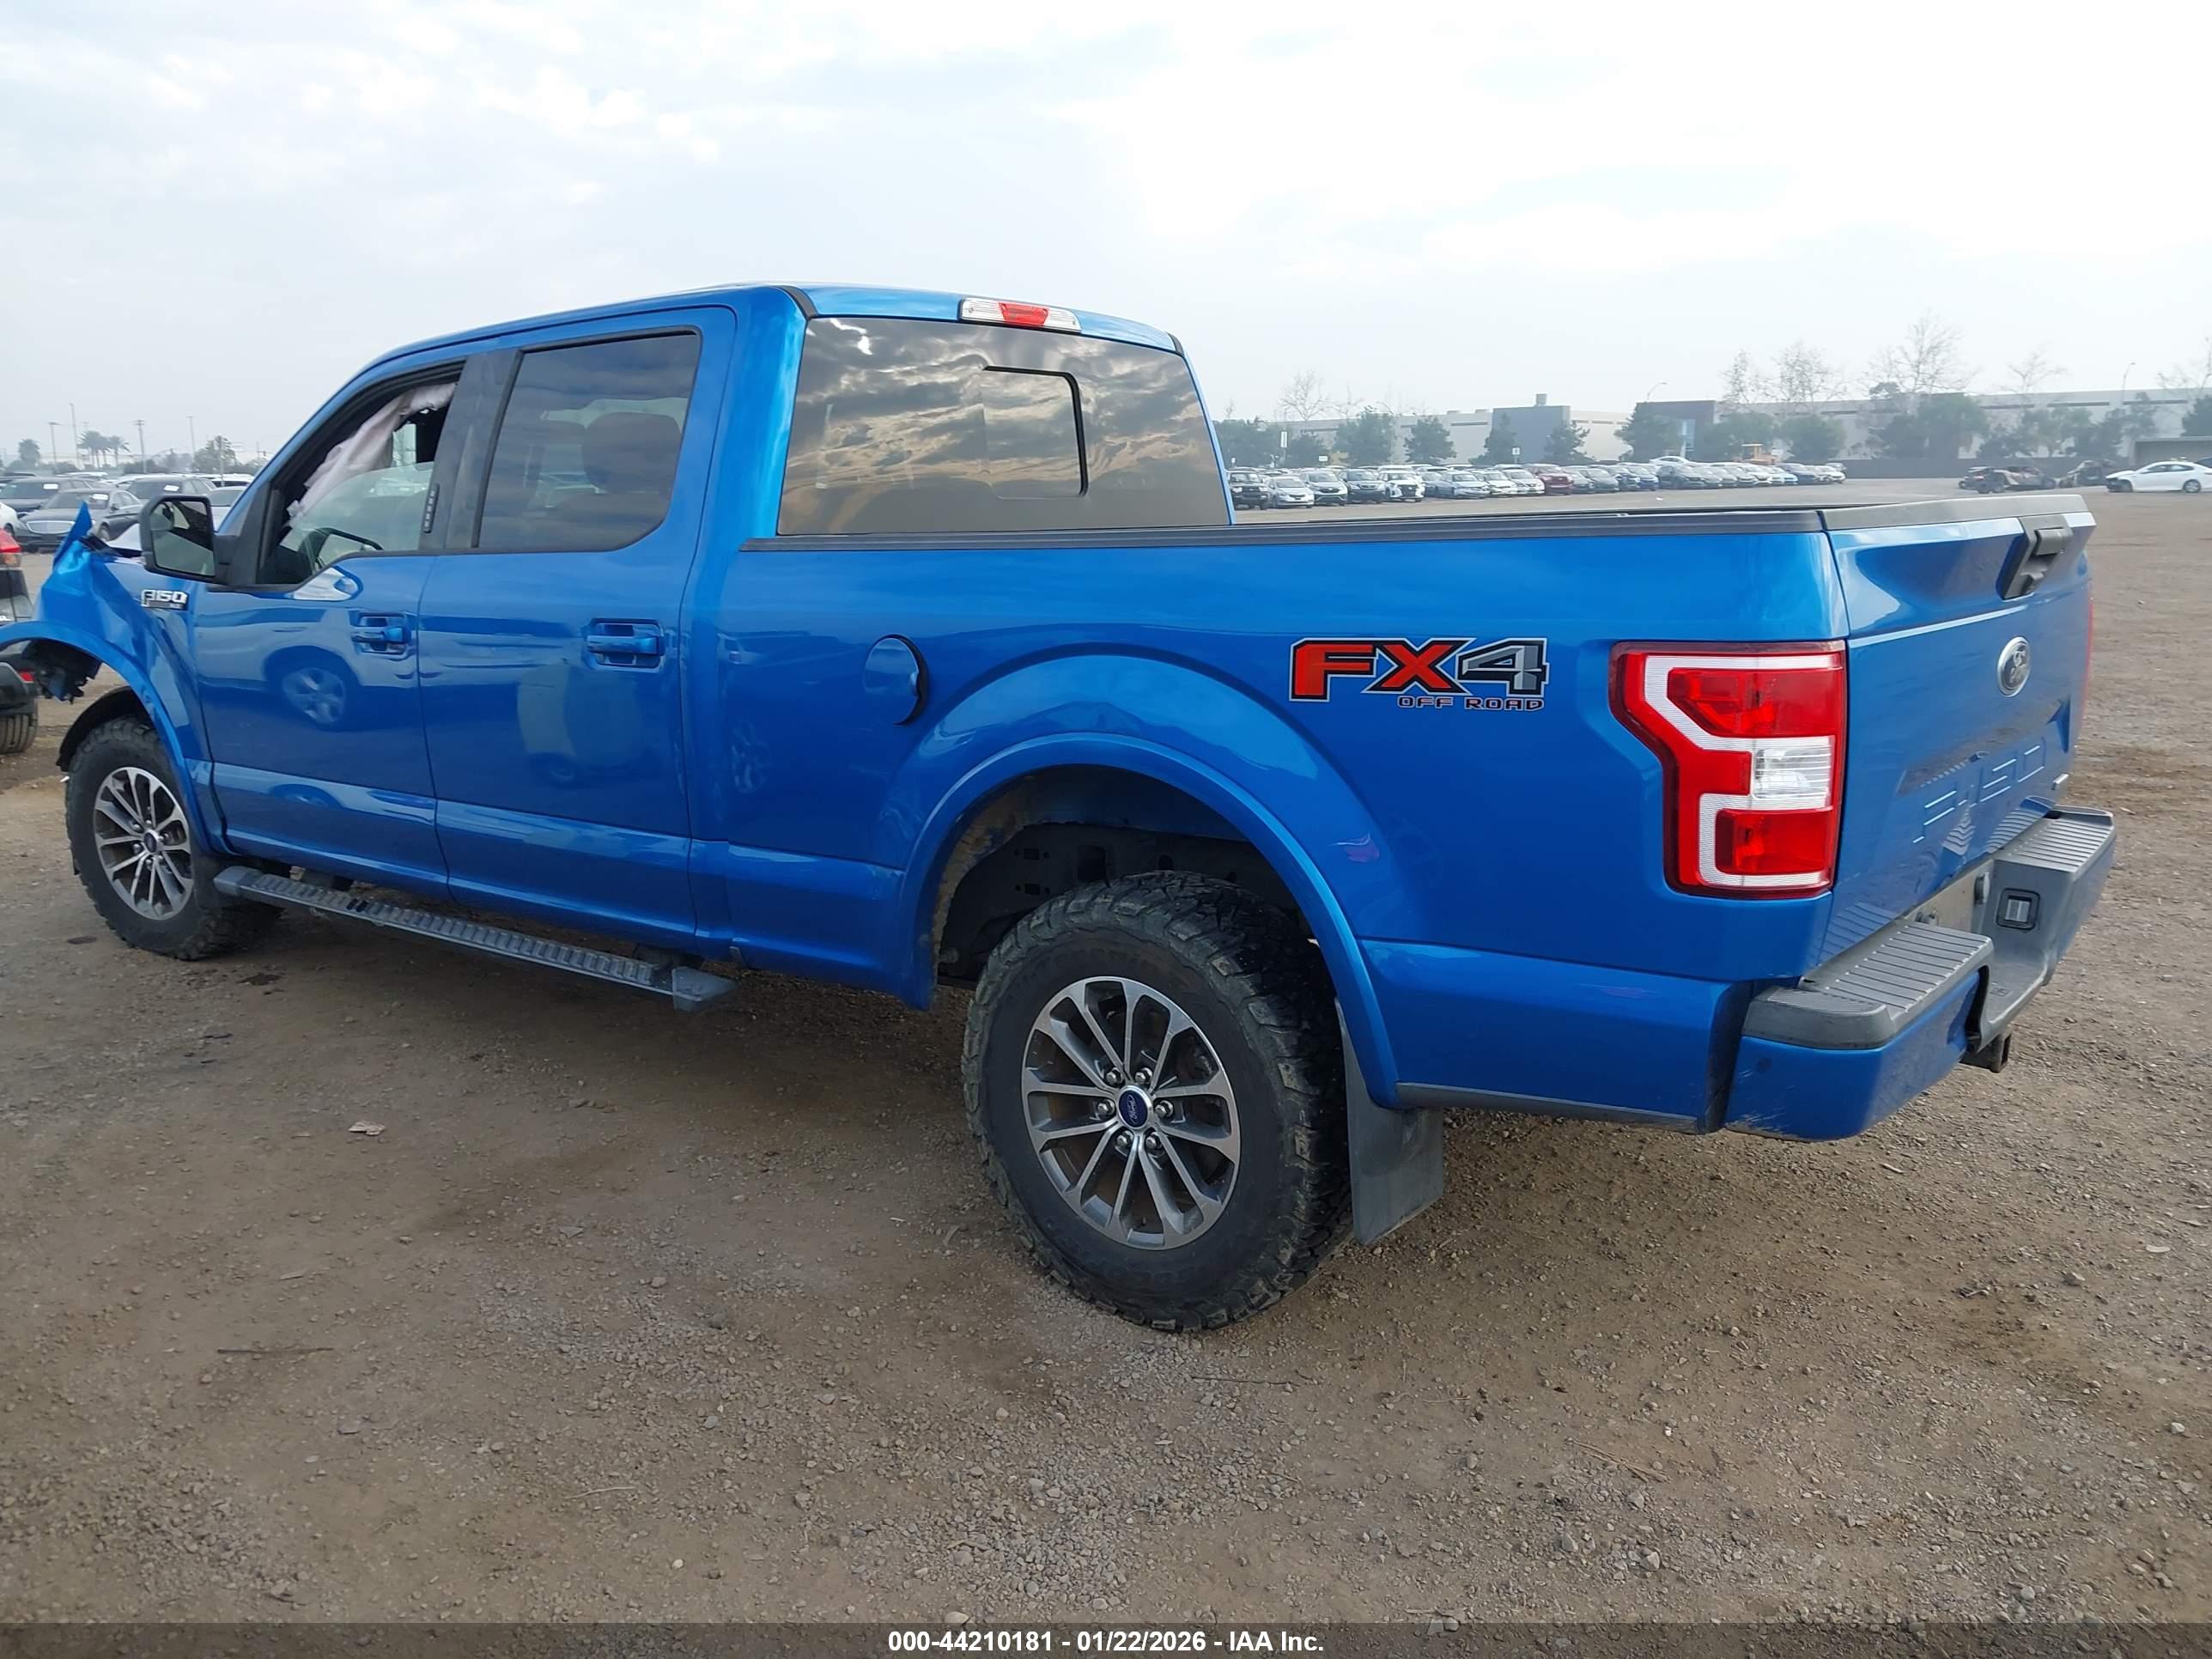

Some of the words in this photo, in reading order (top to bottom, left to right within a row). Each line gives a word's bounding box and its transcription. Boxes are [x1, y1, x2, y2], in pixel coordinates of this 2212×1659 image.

[1289, 638, 1549, 702] FX4
[1396, 695, 1453, 708] OFF
[1463, 696, 1544, 711] ROAD
